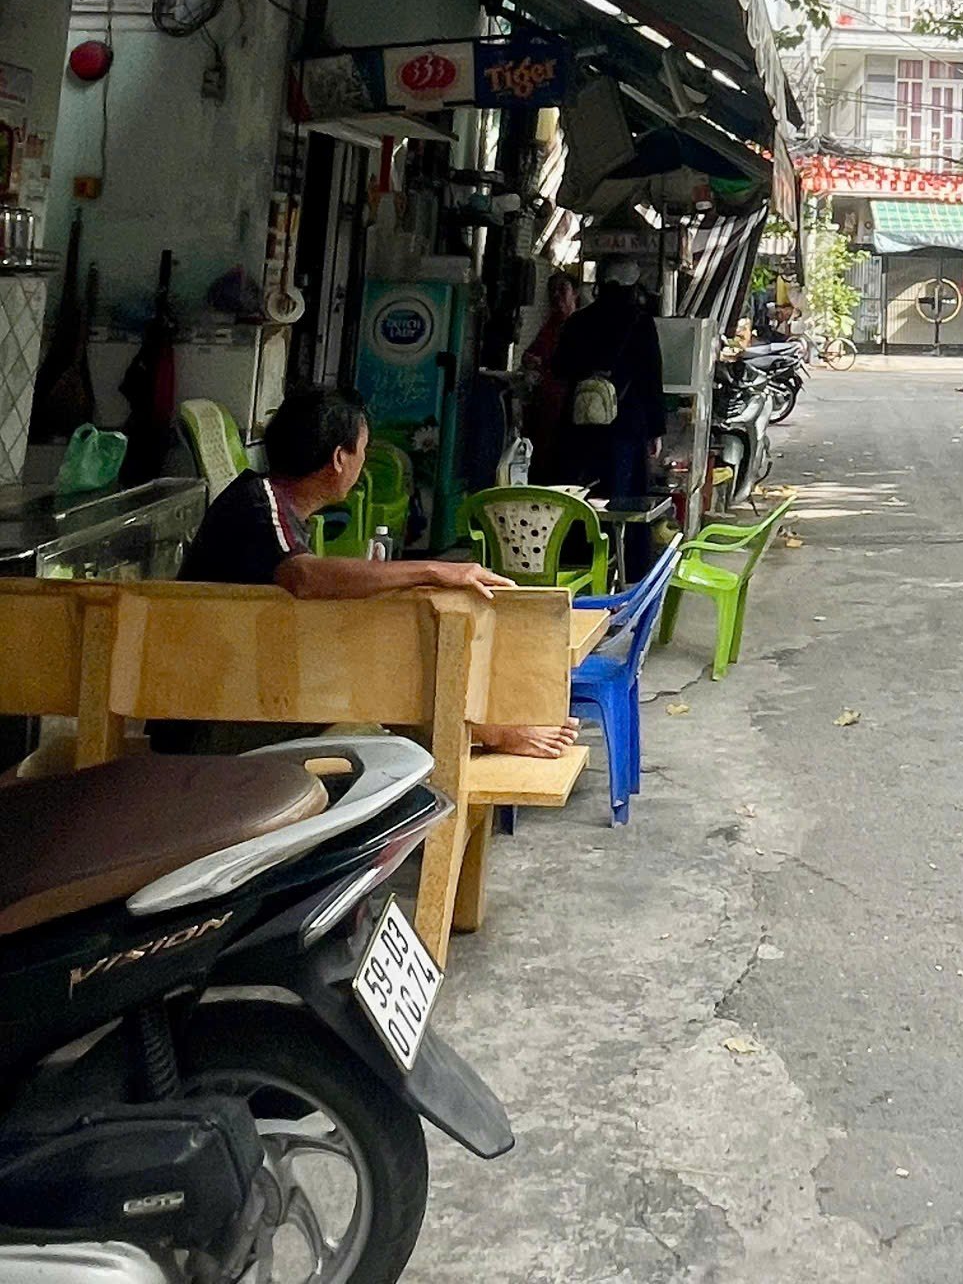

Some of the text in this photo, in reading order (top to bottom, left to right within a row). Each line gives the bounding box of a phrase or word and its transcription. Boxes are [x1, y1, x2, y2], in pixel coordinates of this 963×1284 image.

[412, 53, 446, 87] 333
[483, 56, 558, 99] Tiger
[363, 916, 409, 1009] 59-D3
[388, 950, 436, 1057] 010.74
